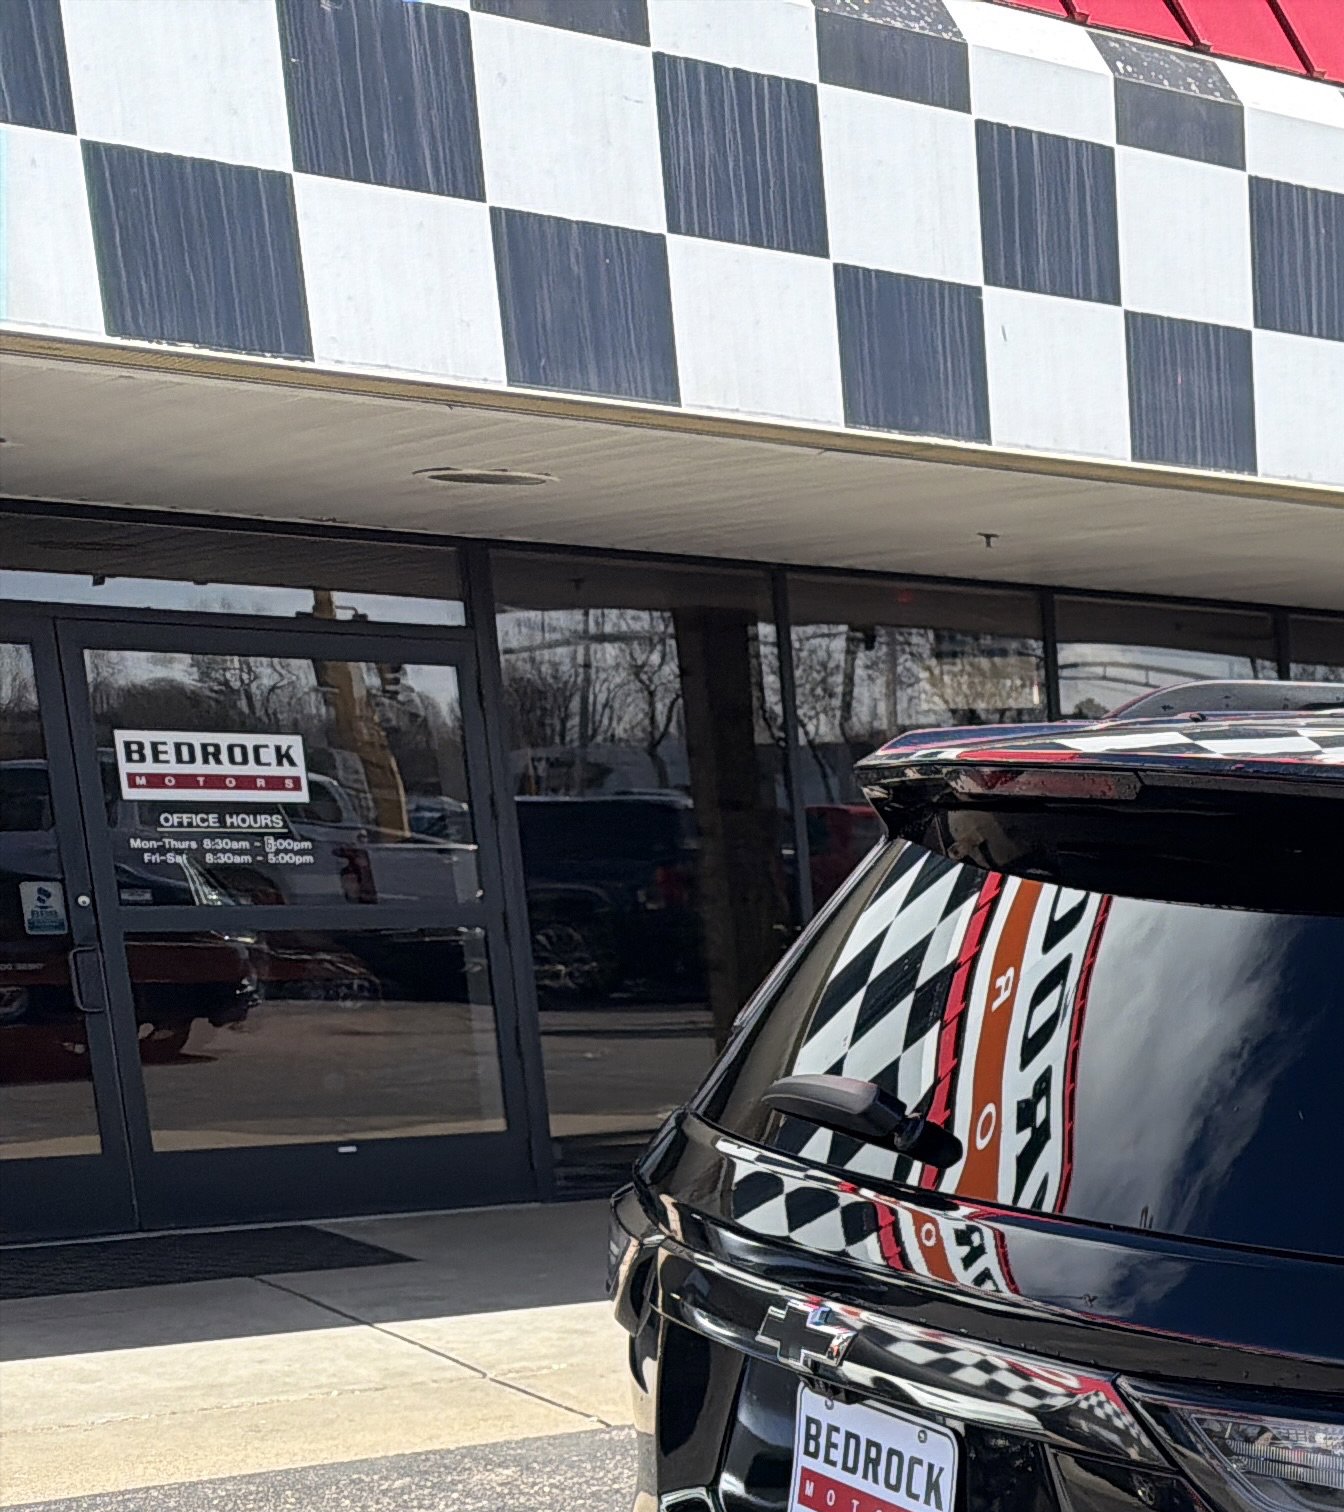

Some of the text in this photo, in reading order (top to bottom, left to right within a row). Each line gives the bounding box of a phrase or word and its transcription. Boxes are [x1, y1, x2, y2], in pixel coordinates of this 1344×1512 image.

[123, 739, 299, 768] BEDROCK
[135, 775, 294, 789] MOTORS
[160, 813, 284, 828] OFFICE HOURS
[130, 837, 198, 850] Mon-Thurs
[202, 838, 250, 850] 8:30am
[144, 853, 188, 864] Fri-Sat
[205, 853, 252, 864] 8:30am
[267, 853, 314, 865] 5:00pm
[802, 1414, 944, 1512] BEDROCK
